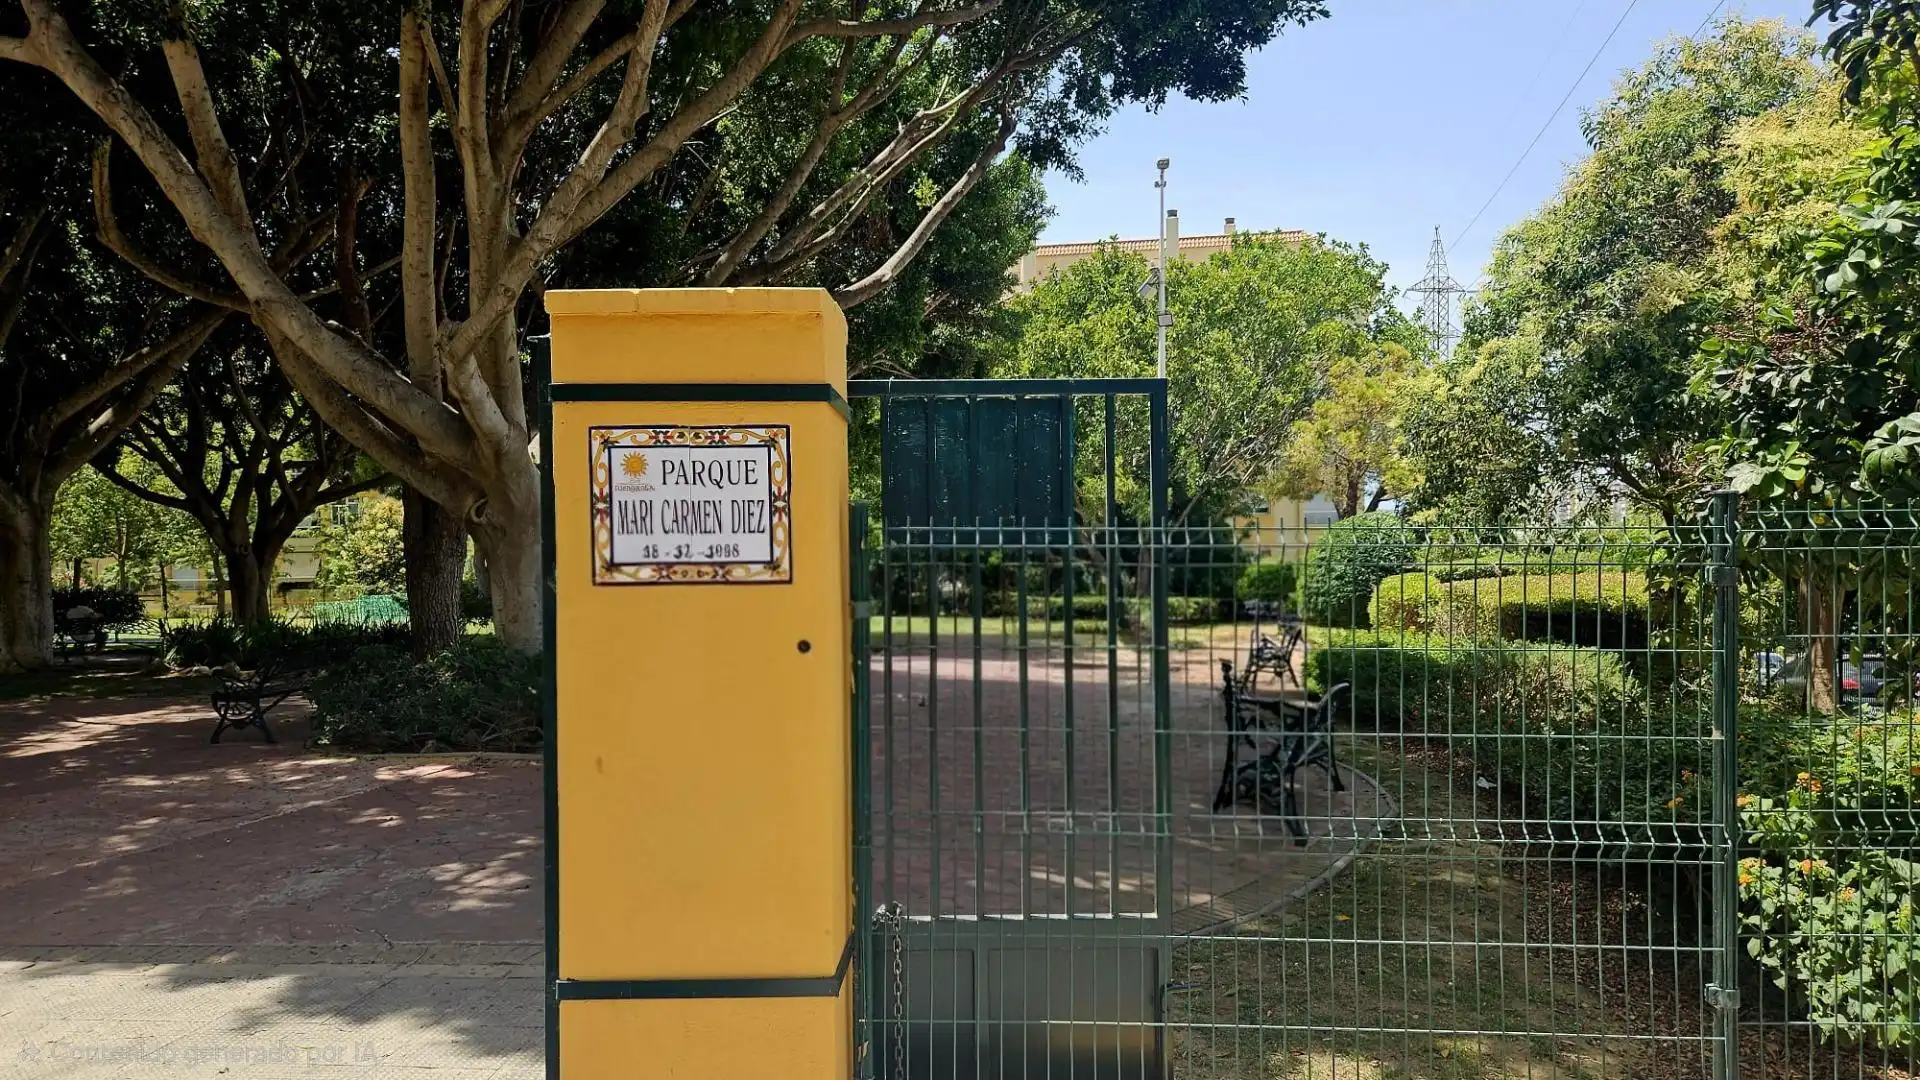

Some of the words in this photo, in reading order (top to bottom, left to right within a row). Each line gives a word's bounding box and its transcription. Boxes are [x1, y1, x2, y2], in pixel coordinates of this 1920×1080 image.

[661, 459, 758, 489] PARQUE
[617, 499, 654, 535] MARI
[660, 498, 723, 536] CARMEN
[731, 499, 766, 534] DIEZ
